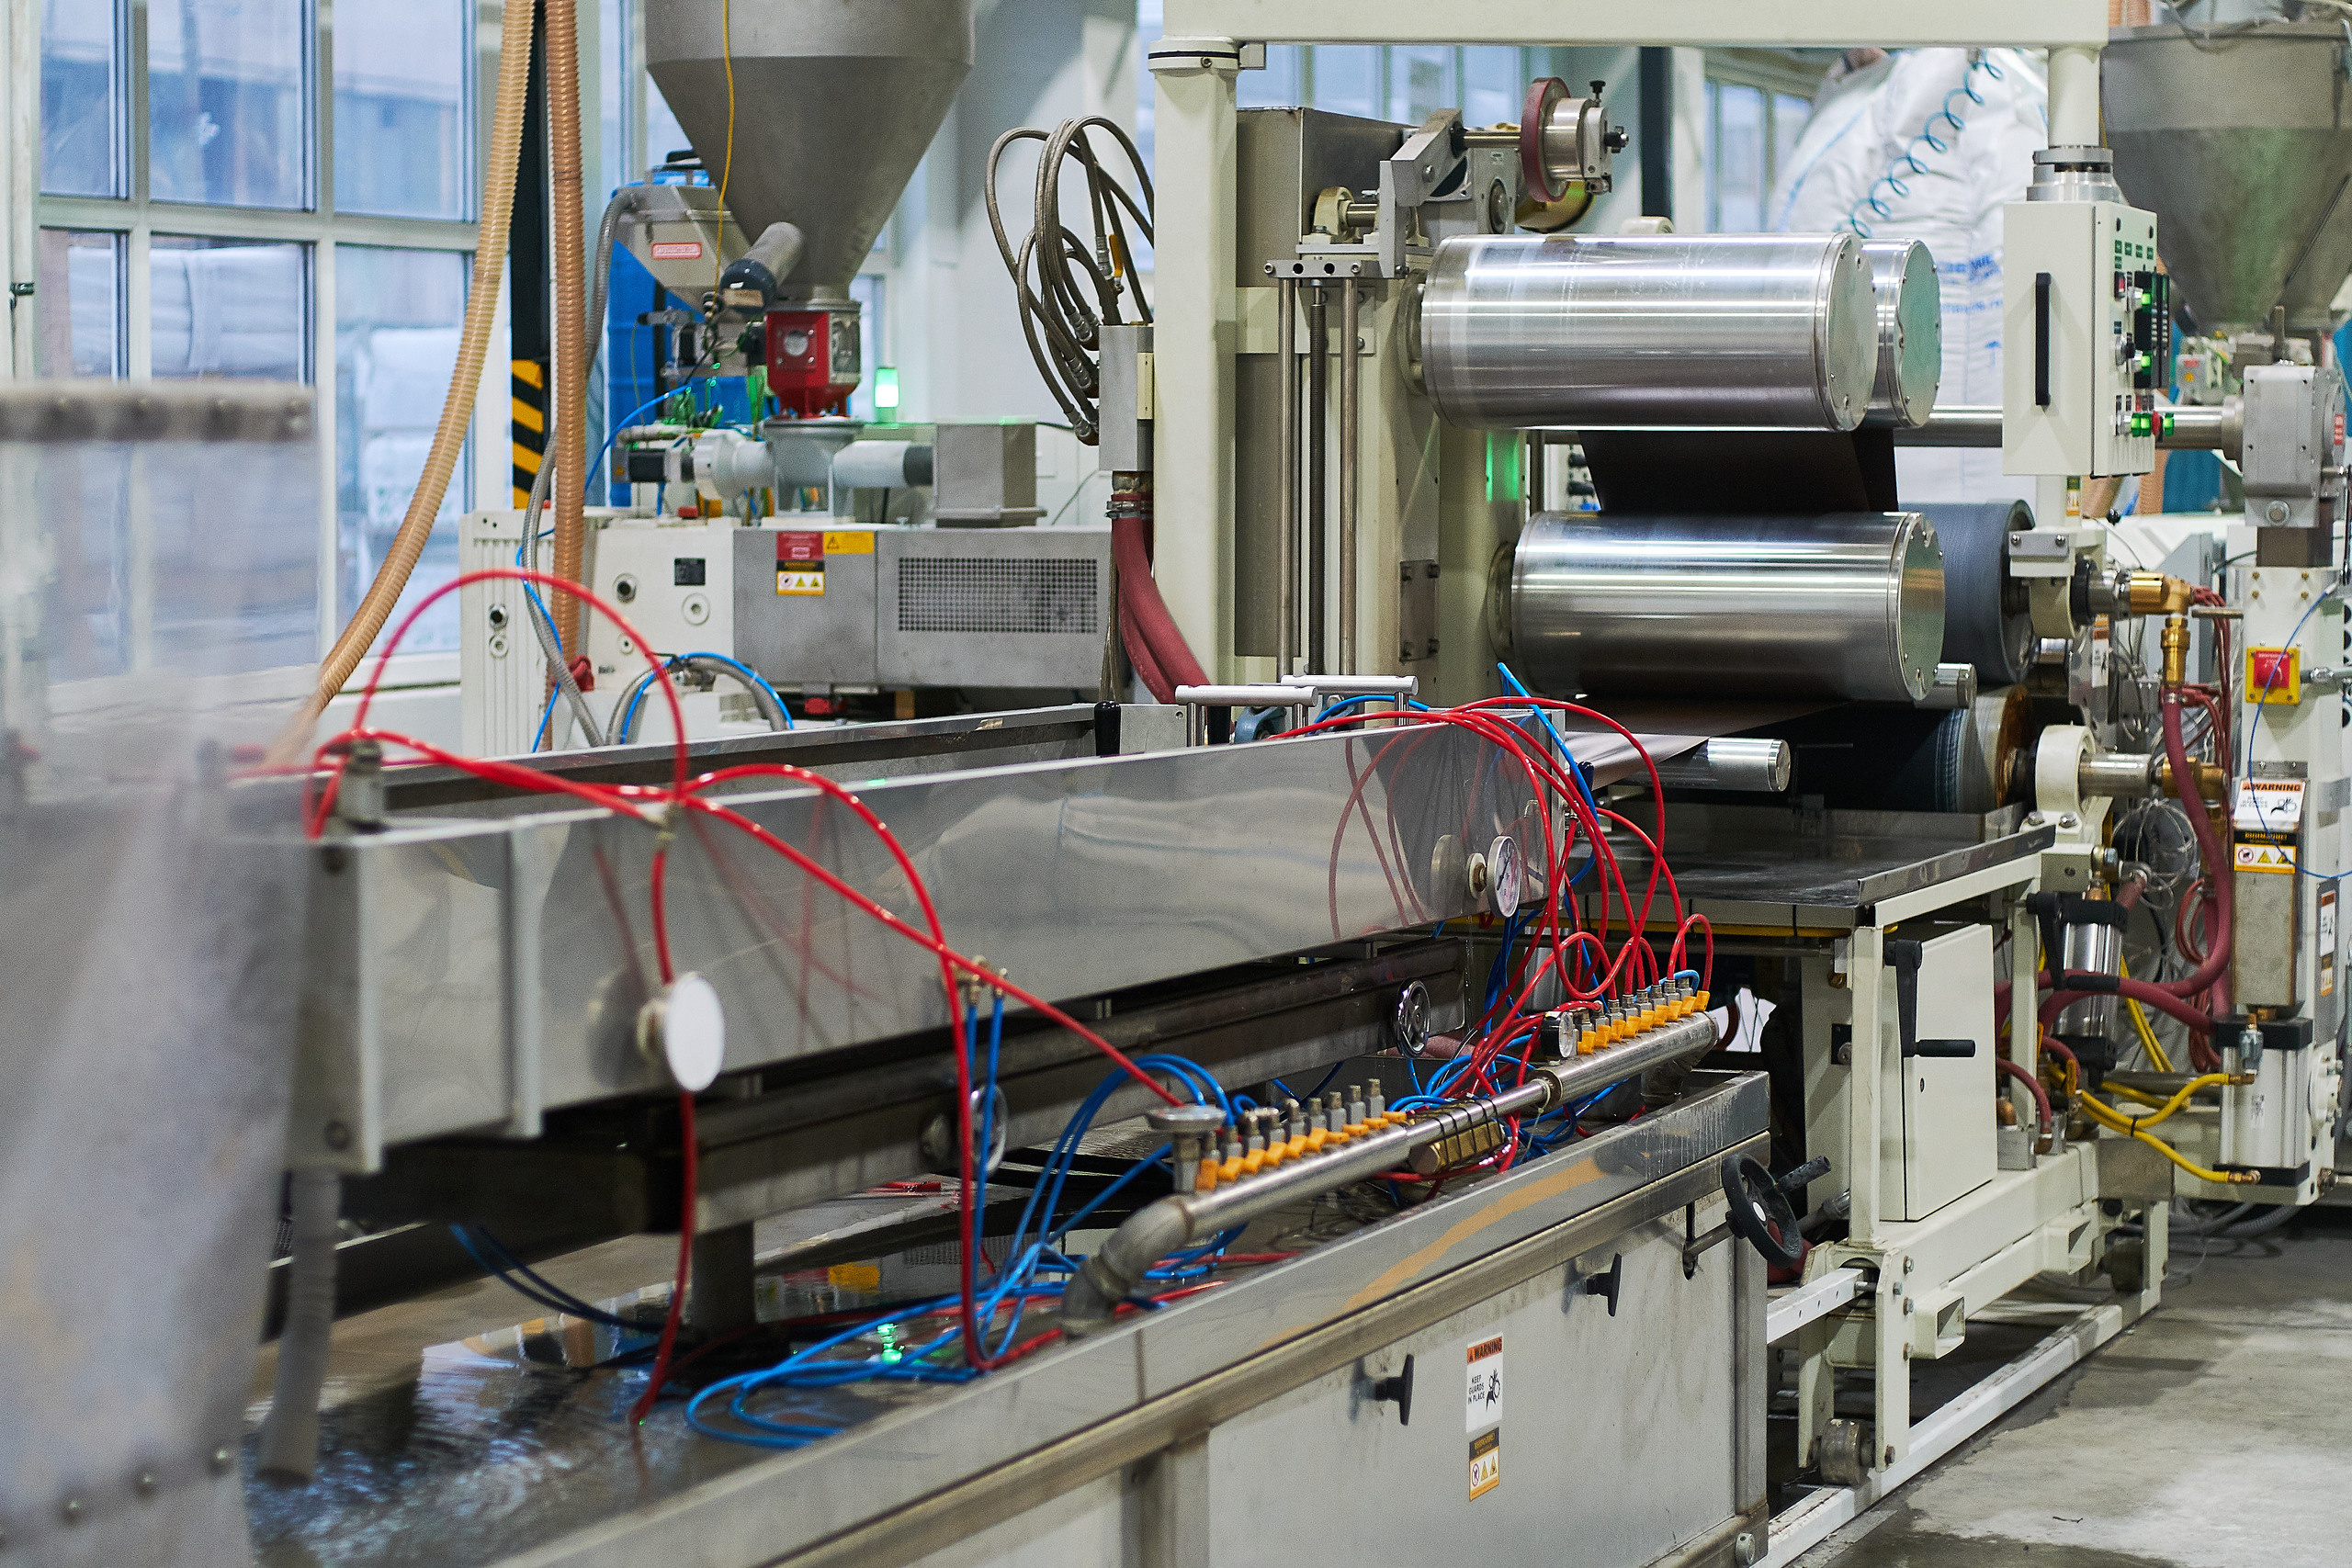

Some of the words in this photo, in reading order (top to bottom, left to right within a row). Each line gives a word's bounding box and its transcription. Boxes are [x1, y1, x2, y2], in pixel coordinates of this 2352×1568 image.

[2253, 784, 2301, 792] WARNING
[1474, 1338, 1502, 1360] WARNING
[1471, 1374, 1482, 1384] KEEP
[1468, 1383, 1485, 1395] GUARDS
[1473, 1391, 1486, 1404] PLACE
